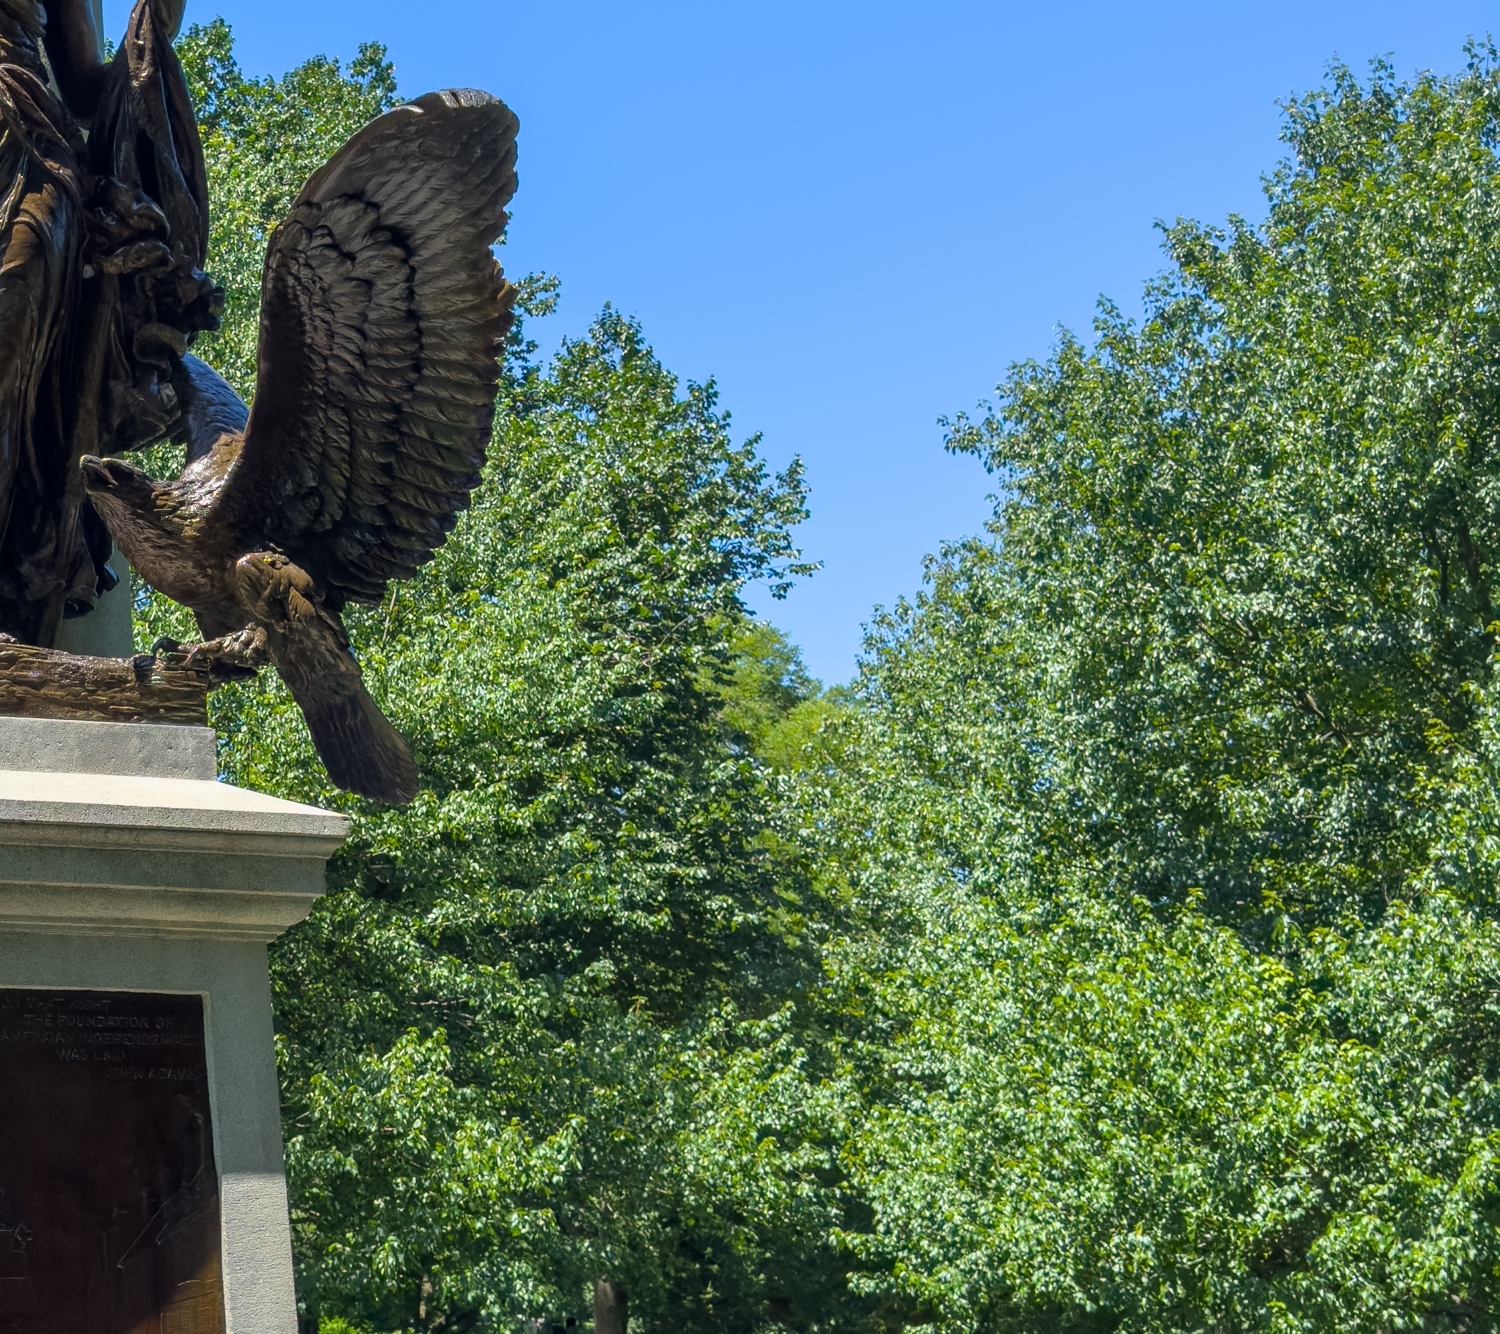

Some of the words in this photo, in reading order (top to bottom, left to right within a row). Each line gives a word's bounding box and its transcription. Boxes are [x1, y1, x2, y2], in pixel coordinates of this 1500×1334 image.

[57, 1015, 150, 1029] FOUNDATION
[57, 1048, 90, 1062] WAS
[148, 1066, 198, 1081] ADAMS
